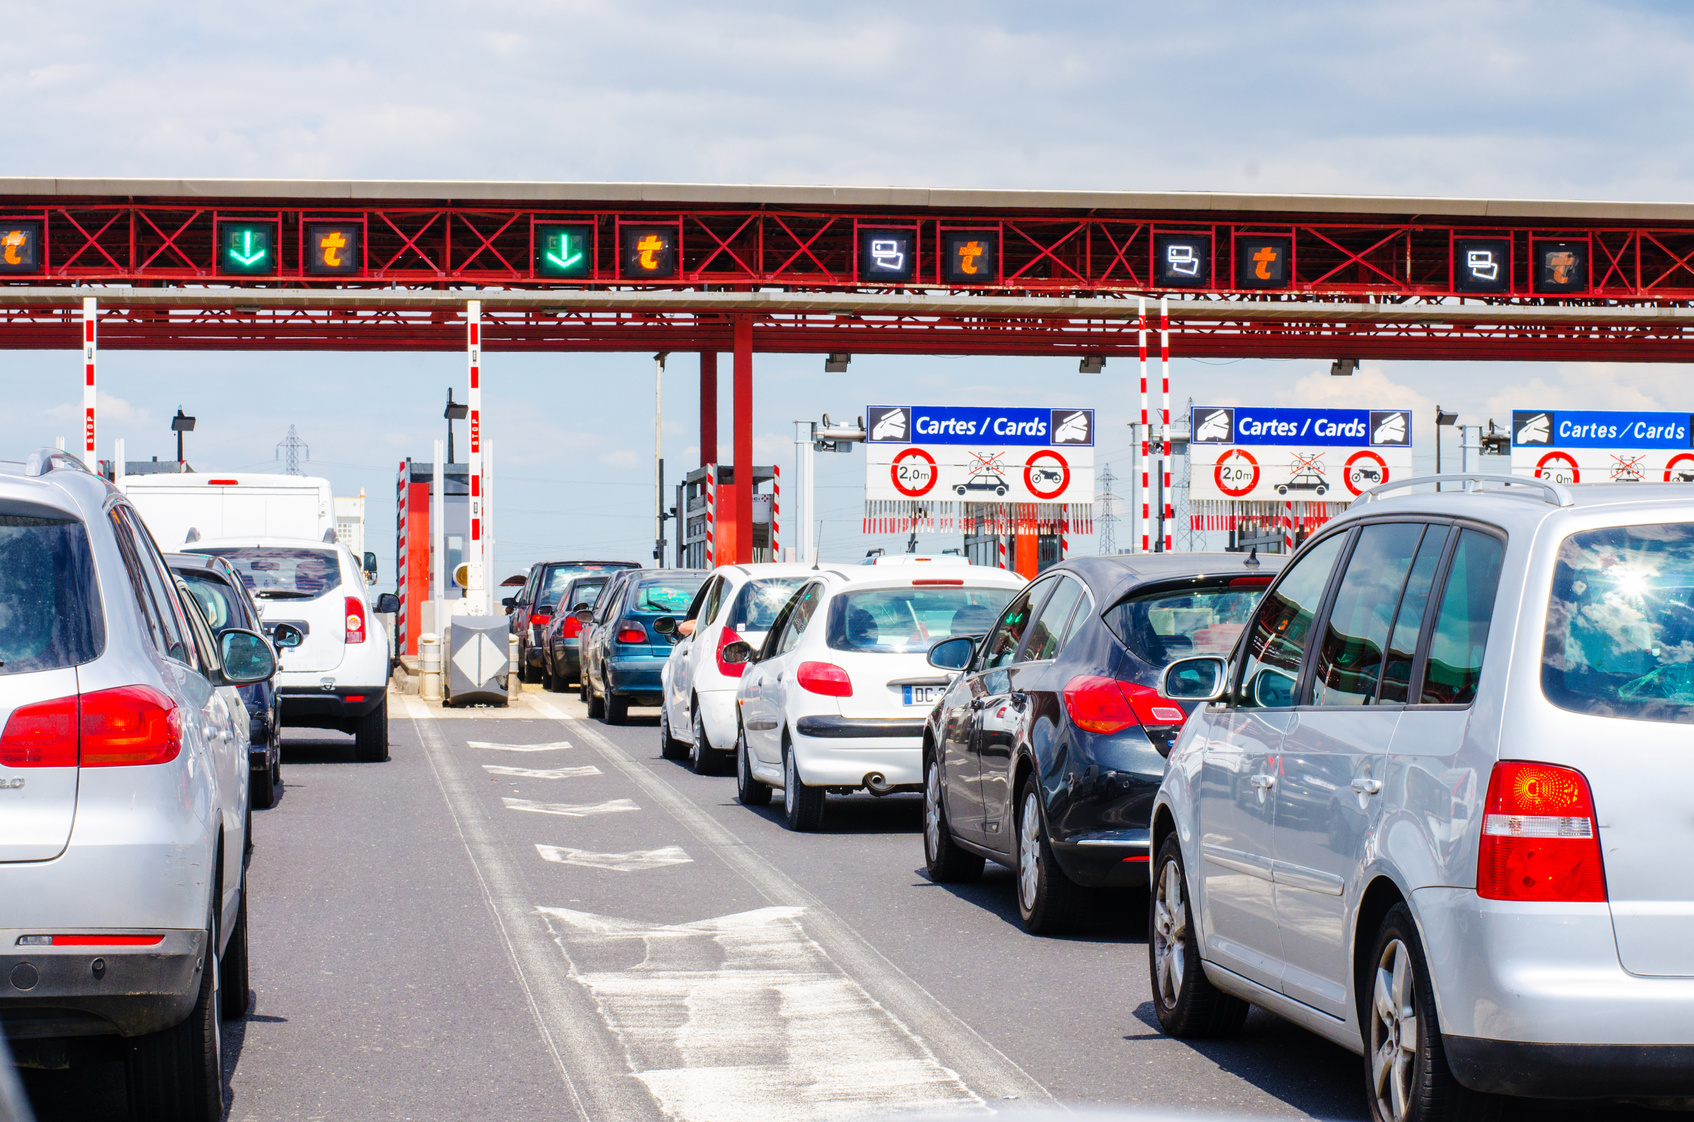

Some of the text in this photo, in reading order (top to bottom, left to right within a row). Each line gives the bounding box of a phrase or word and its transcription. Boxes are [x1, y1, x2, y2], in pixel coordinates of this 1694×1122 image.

[320, 232, 346, 267] t
[637, 235, 662, 270] t
[958, 240, 983, 275] t
[1252, 246, 1277, 280] t
[86, 415, 94, 443] STOP
[471, 418, 479, 446] STOP
[915, 416, 976, 435] Cartes
[993, 417, 1047, 436] Cards
[1238, 417, 1298, 436] Cartes
[1314, 418, 1366, 437] Cards
[1559, 420, 1617, 438] Cartes
[1634, 421, 1685, 439] Cards
[899, 466, 930, 481] 2,0m
[1222, 466, 1253, 482] 2,0m
